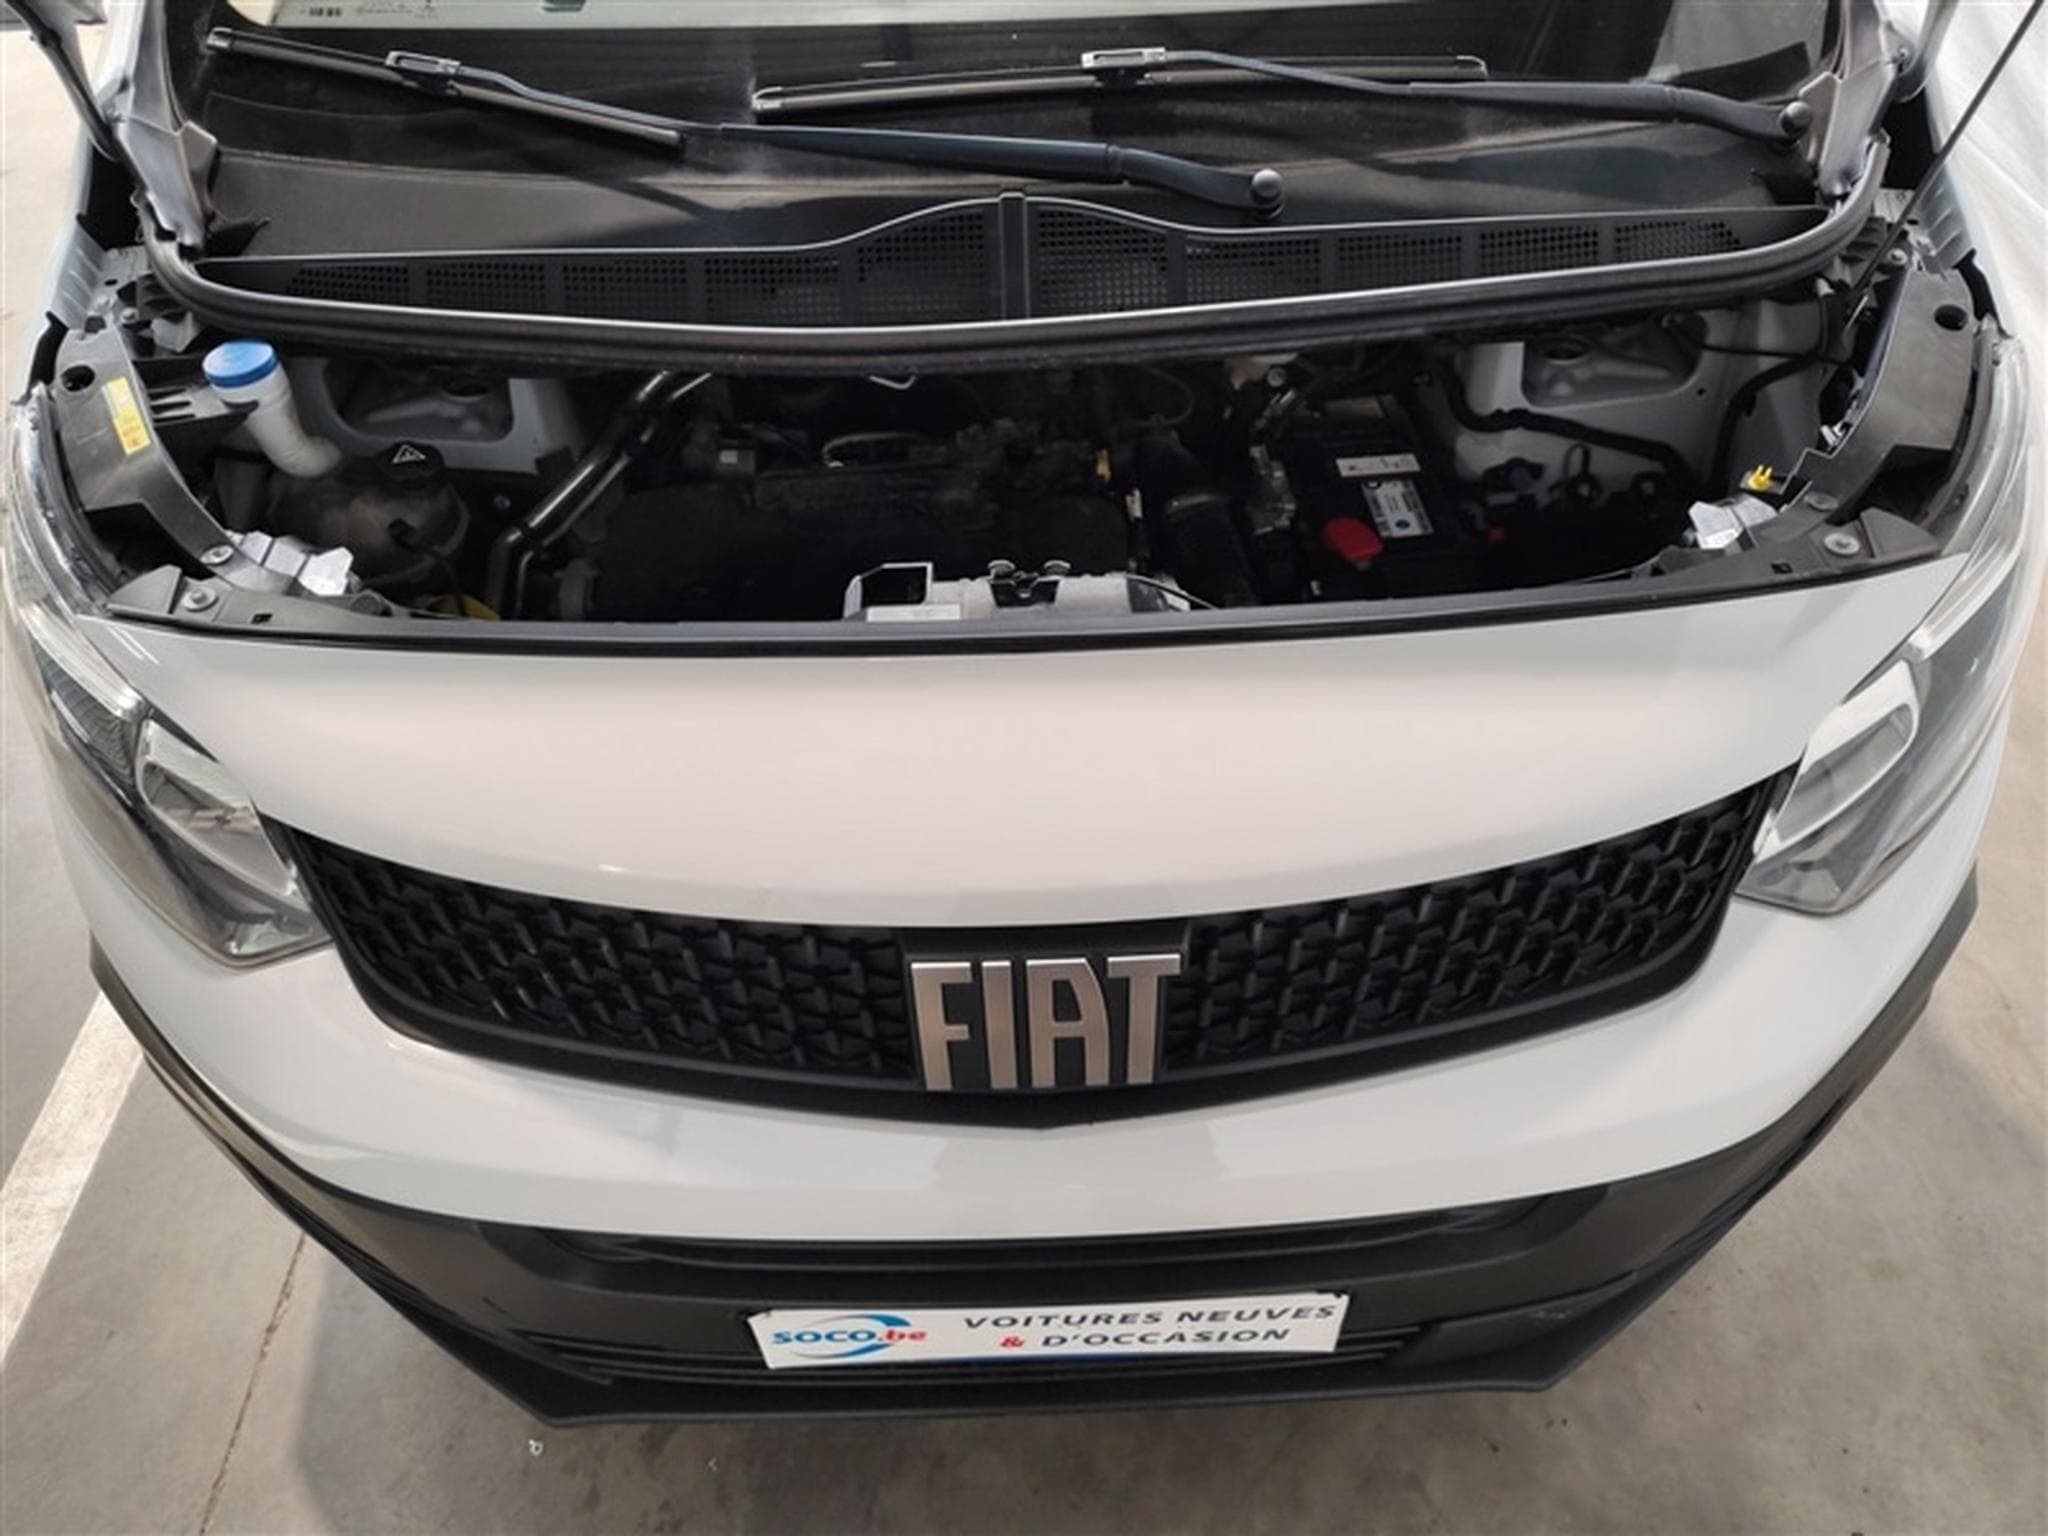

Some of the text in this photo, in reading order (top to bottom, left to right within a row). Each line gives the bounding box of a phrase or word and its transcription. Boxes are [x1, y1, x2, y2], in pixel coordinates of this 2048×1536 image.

[911, 954, 1181, 1091] FIAT
[964, 1305, 1337, 1329] VOITURES NEUVES
[1000, 1329, 1290, 1348] & D'OCCASION
